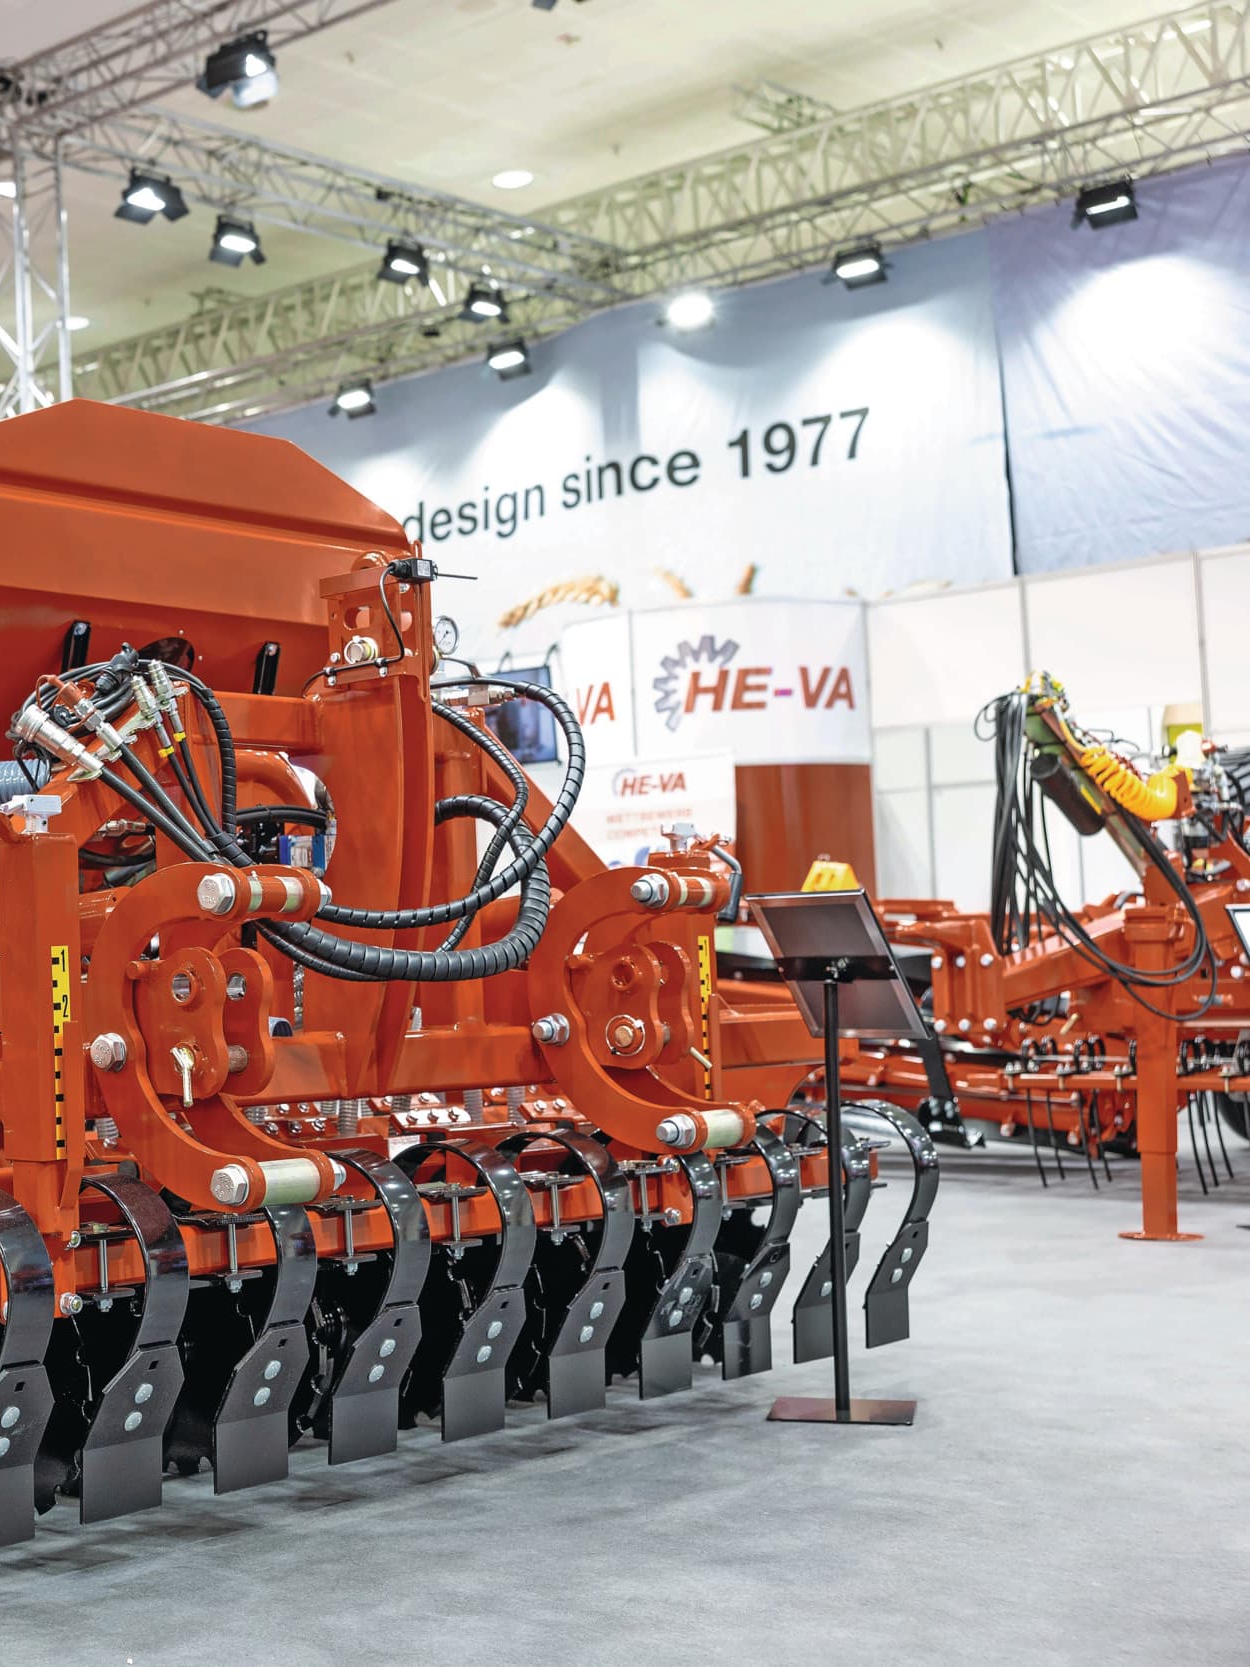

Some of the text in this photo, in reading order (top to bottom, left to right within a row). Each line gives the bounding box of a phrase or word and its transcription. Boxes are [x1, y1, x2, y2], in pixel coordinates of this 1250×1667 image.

[402, 407, 870, 544] design since 1977
[683, 665, 856, 714] HE-VA
[620, 771, 687, 797] HE-VA
[60, 949, 66, 973] 1
[62, 994, 69, 1018] 2
